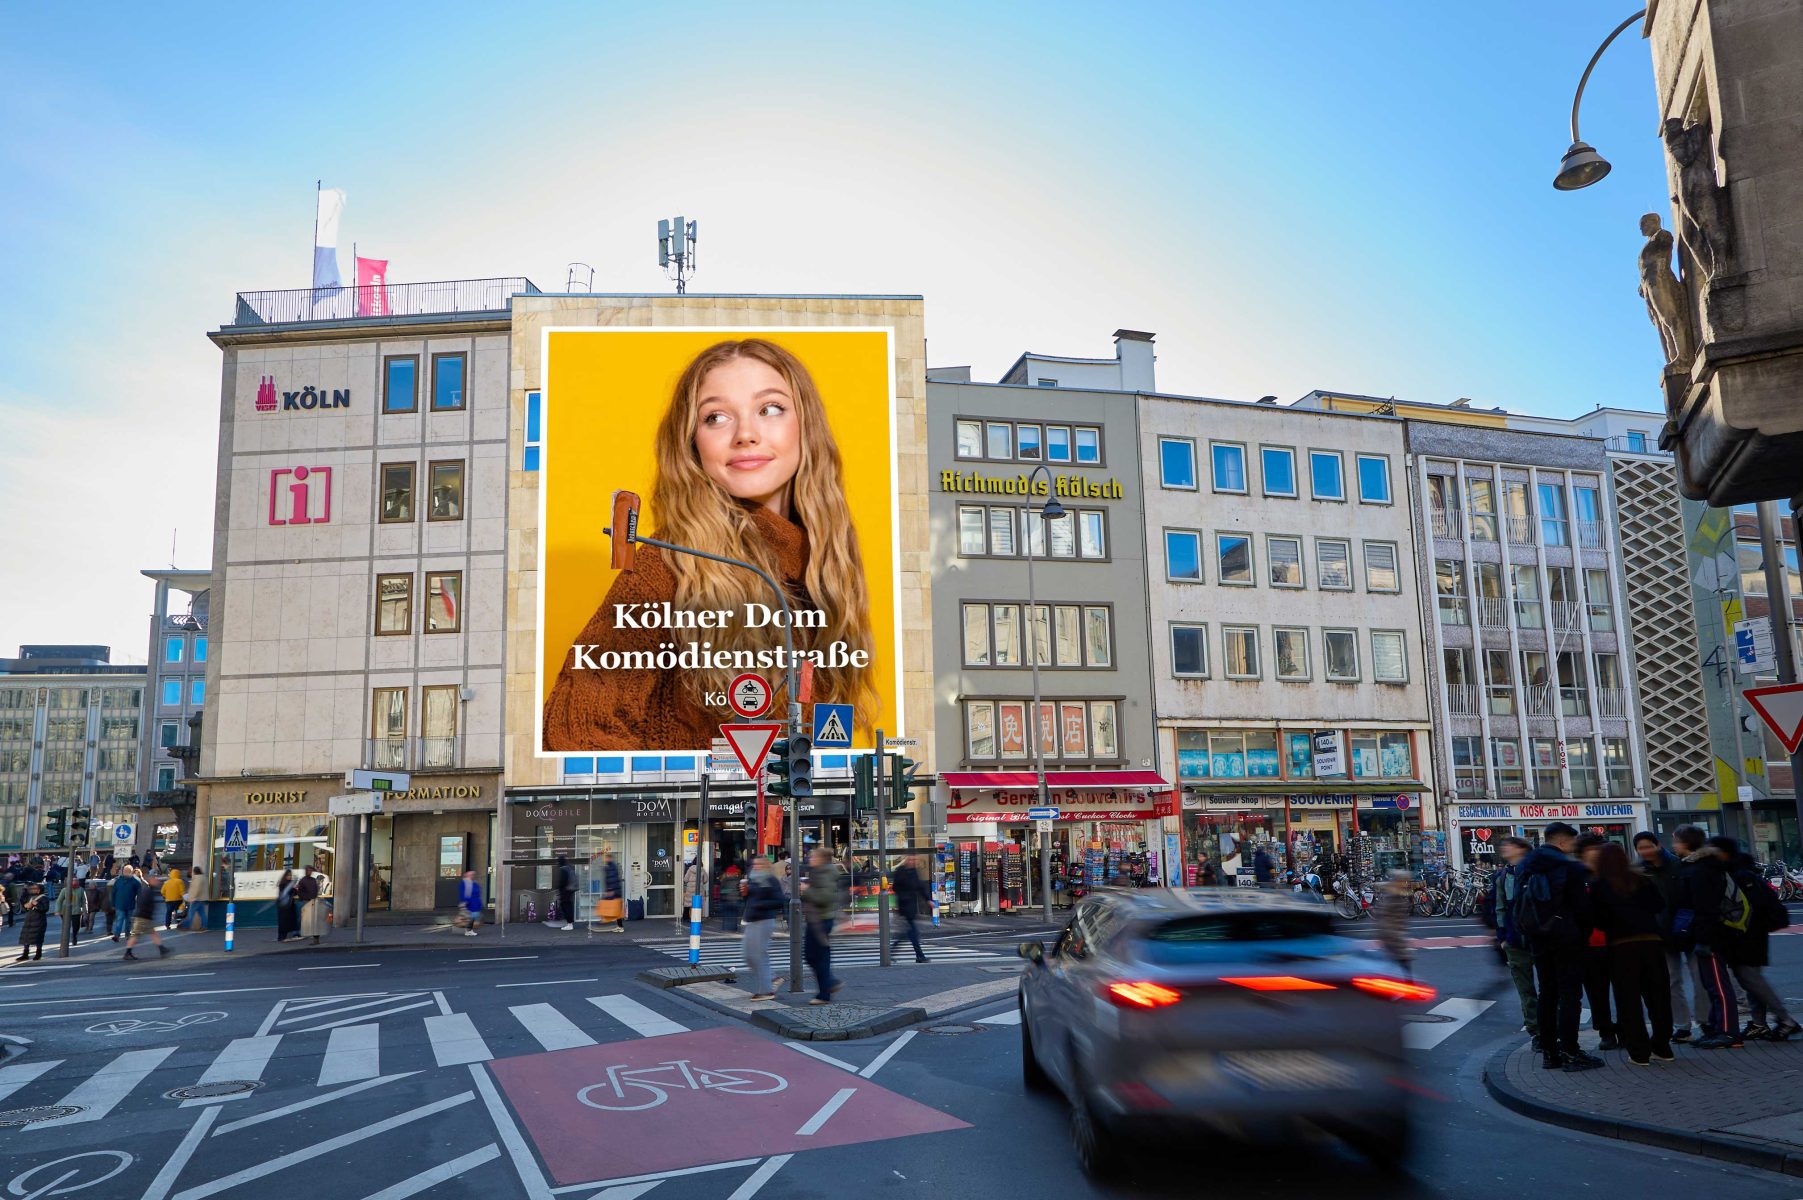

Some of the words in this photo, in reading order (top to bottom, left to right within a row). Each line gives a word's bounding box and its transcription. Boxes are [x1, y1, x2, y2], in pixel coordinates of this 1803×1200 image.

[283, 386, 350, 410] KÖLN
[1056, 474, 1124, 498] Kölsch
[613, 602, 734, 629] Kölner
[744, 603, 828, 628] Dom
[571, 641, 869, 670] Komödienstraße
[885, 738, 918, 747] Komödienstr.
[1558, 740, 1567, 769] KIOSK
[244, 790, 307, 804] TOURIST
[1209, 796, 1239, 804] Souvenir
[1241, 795, 1259, 805] Shop
[1290, 795, 1352, 805] SOUVENIR
[637, 799, 672, 820] DOM
[709, 802, 744, 814] mangal
[1458, 805, 1512, 818] GESCHENKARTIKEL
[1519, 804, 1545, 817] KIOSK
[1547, 807, 1559, 817] am
[1562, 804, 1579, 816] DOM
[1585, 804, 1633, 816] SOUVENIR
[966, 813, 1007, 822] Original
[1010, 812, 1029, 821] Bla
[1073, 812, 1107, 820] Cuckoo
[1109, 811, 1138, 819] Clocks
[1470, 842, 1495, 854] Köln
[1239, 879, 1252, 887] 140
